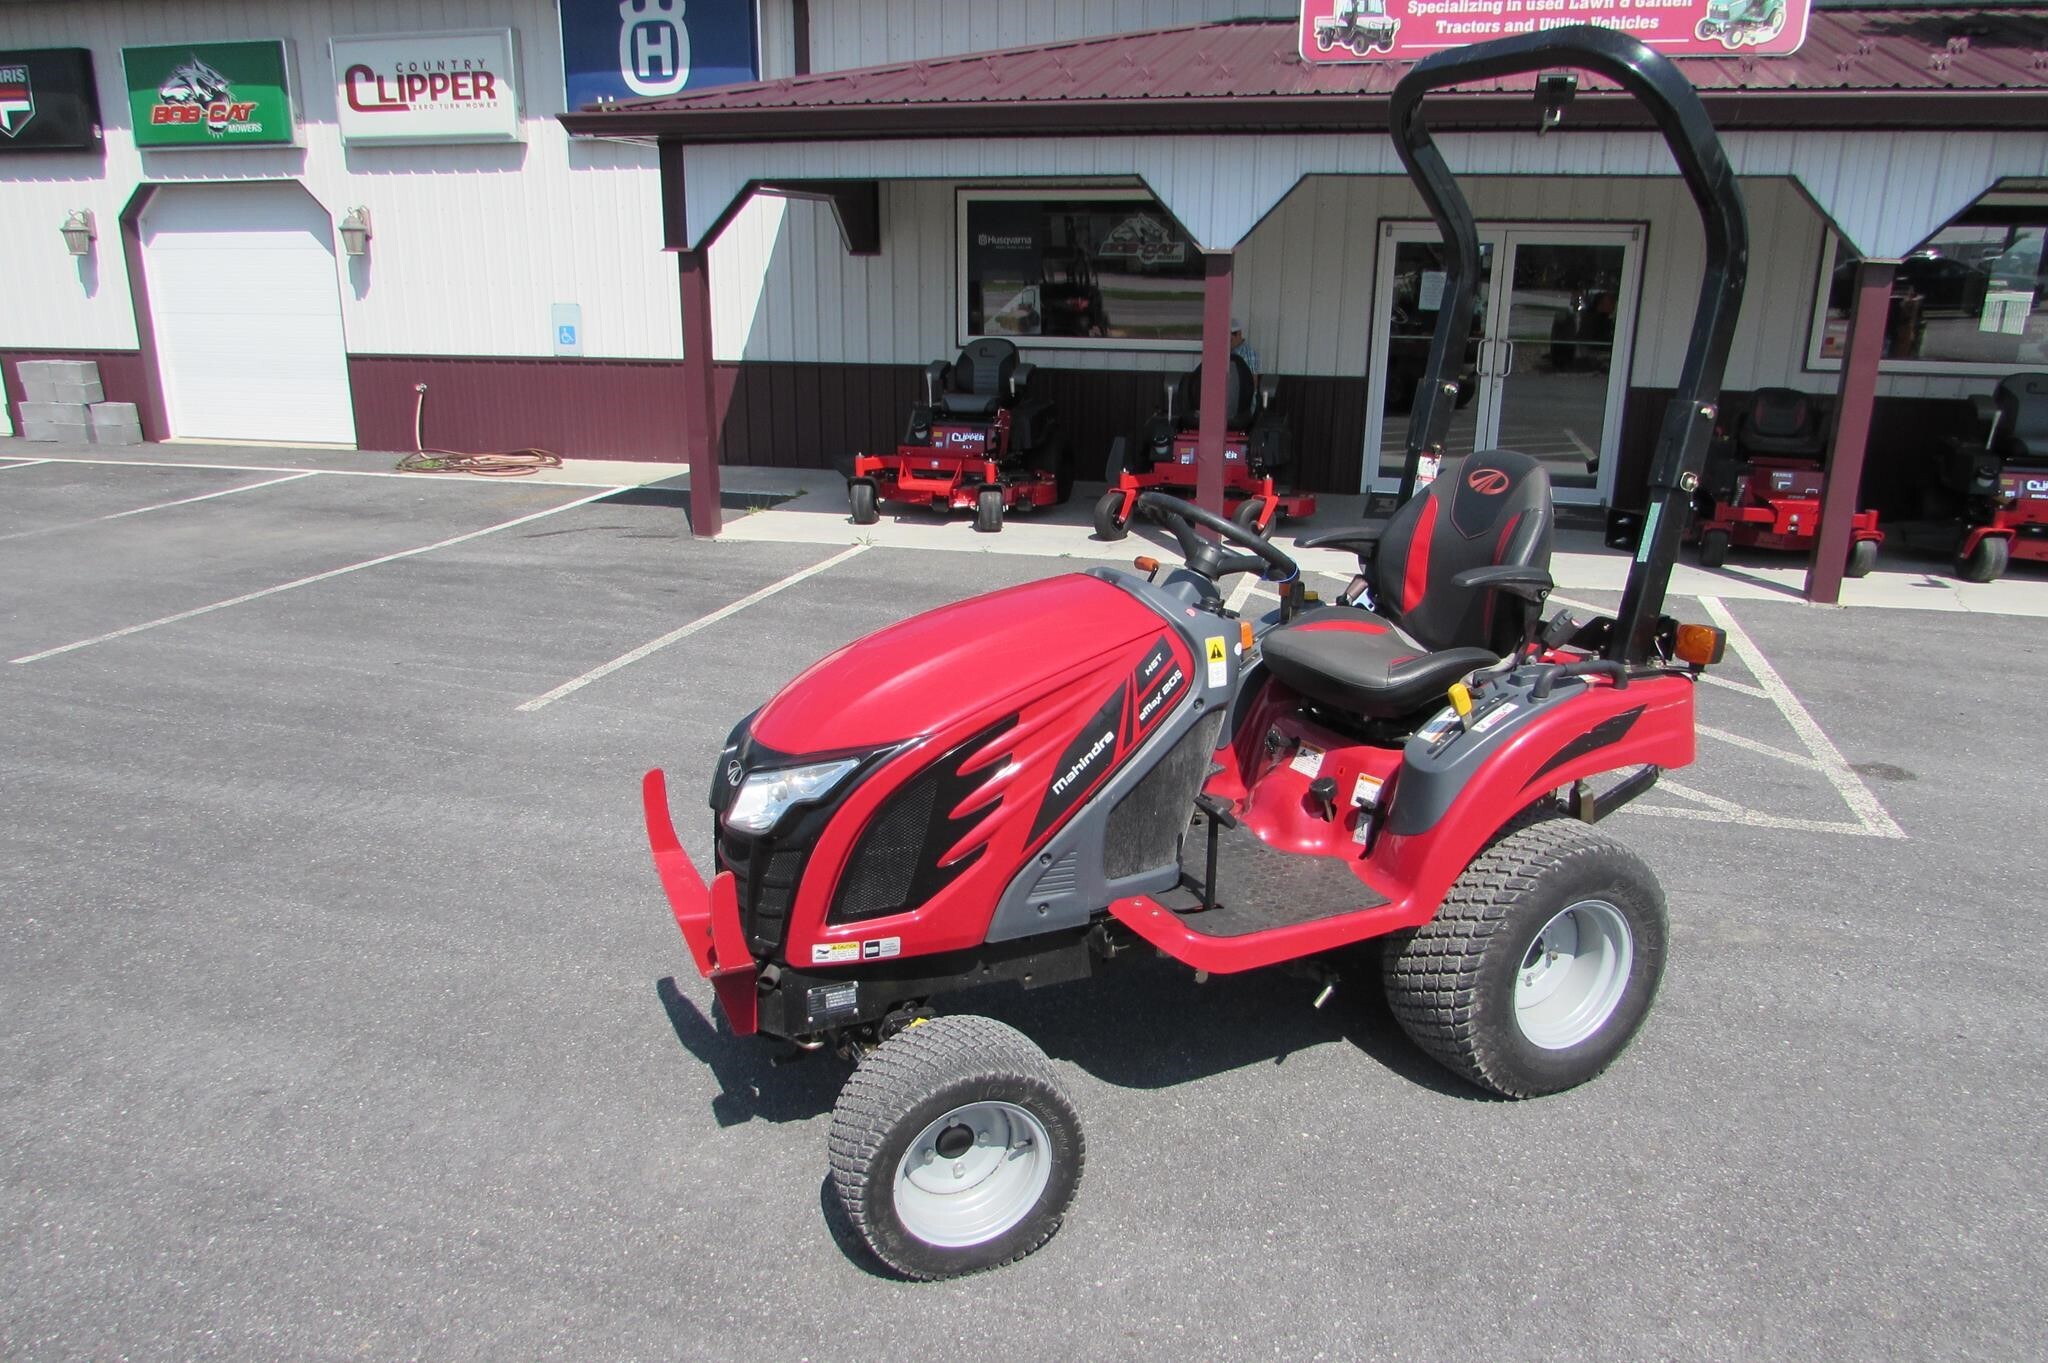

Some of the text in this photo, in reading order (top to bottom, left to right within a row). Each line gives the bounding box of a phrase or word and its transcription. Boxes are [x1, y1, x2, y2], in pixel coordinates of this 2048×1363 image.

[1408, 0, 1502, 16] Specializing
[1506, 0, 1522, 11] in
[1526, 0, 1564, 11] used
[1568, 0, 1615, 10] Lawn
[1435, 20, 1500, 34] Tractors
[1504, 18, 1535, 32] and
[1590, 14, 1660, 30] Vehicles
[396, 58, 486, 72] COUNTRY
[345, 63, 497, 113] CLIPPER
[152, 101, 258, 125] BOB-CAT
[413, 101, 498, 110] ZERO TURN MOWER
[227, 122, 263, 133] MOWERS
[987, 234, 1032, 246] Husqvarna
[1145, 652, 1163, 676] HST
[1163, 669, 1183, 696] 20S
[1052, 730, 1115, 795] Mahindra
